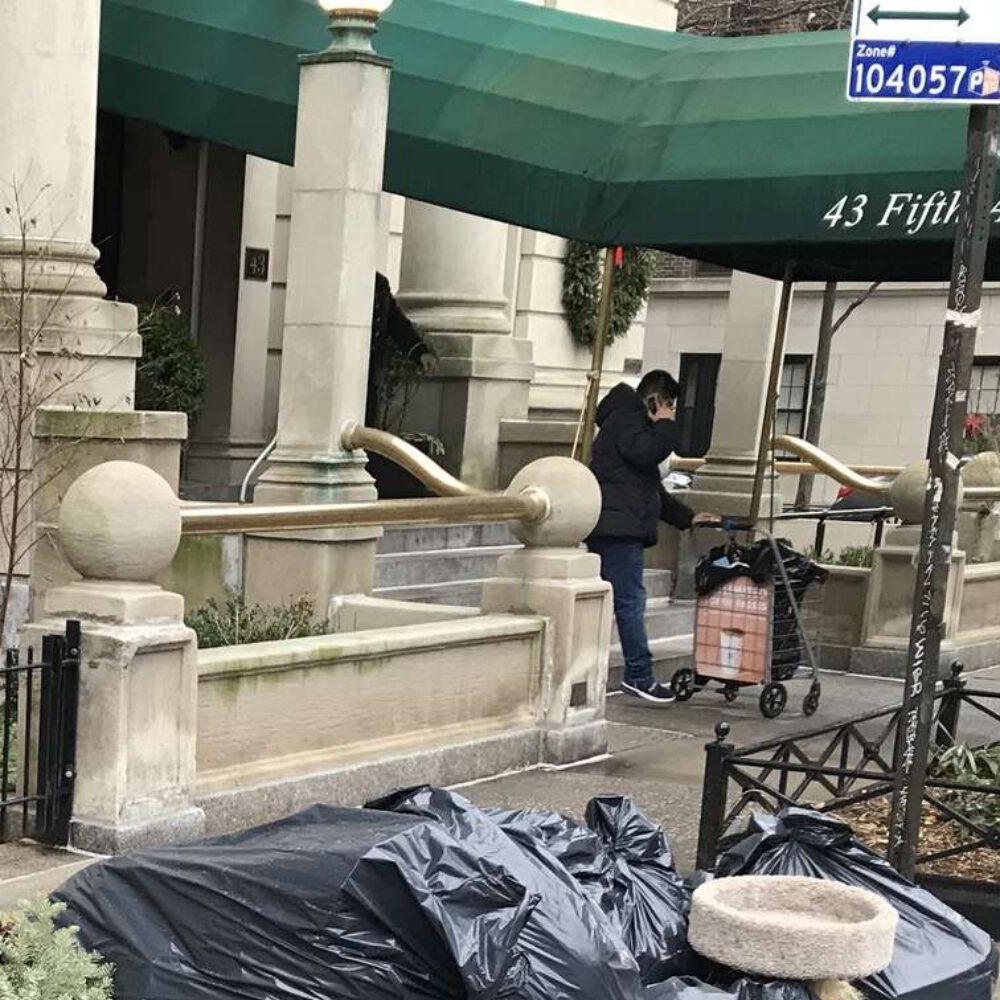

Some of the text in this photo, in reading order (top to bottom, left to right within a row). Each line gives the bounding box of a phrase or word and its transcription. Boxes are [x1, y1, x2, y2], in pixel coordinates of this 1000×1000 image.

[856, 44, 897, 58] Zone#
[855, 63, 967, 95] 104057
[822, 194, 869, 228] 43
[249, 254, 266, 275] 43
